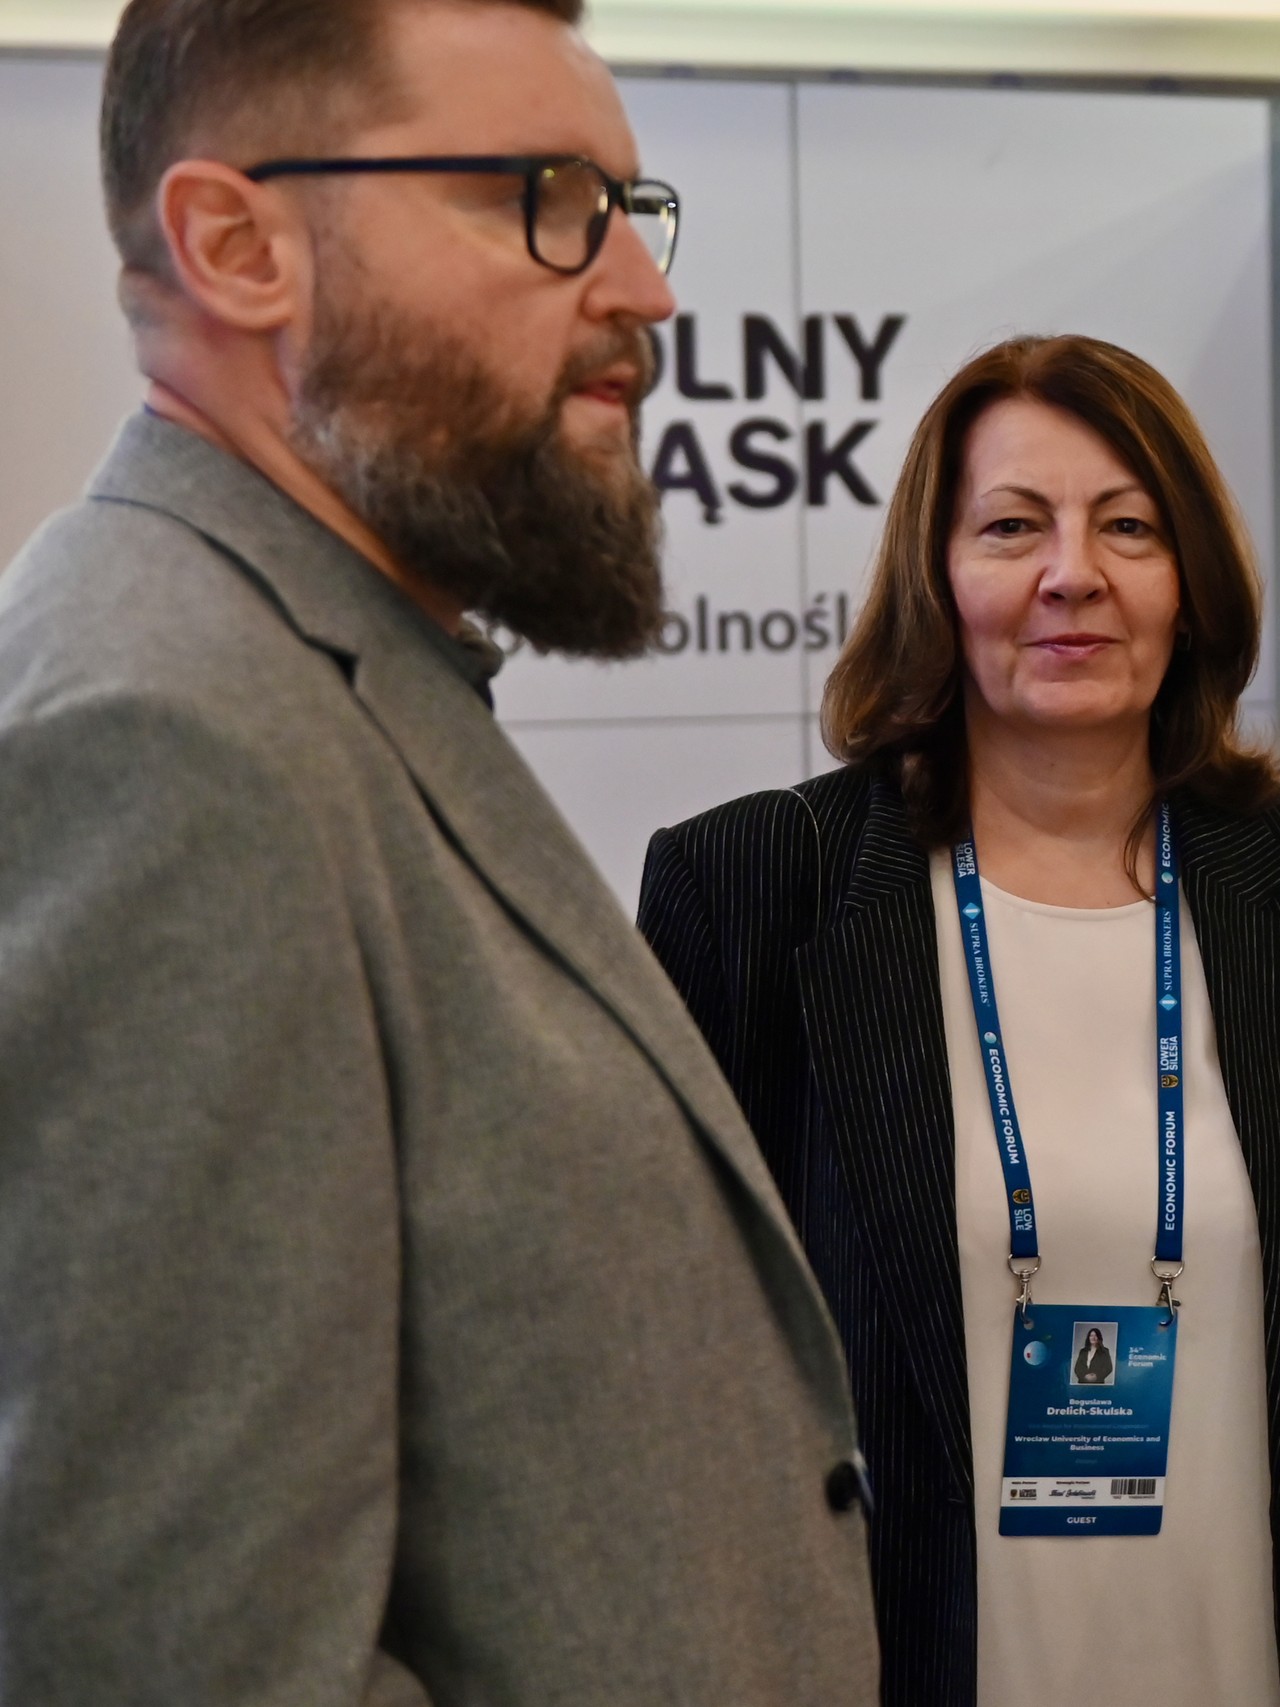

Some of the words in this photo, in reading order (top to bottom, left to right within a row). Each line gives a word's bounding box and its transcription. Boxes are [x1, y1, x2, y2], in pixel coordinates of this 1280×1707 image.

[1162, 802, 1171, 867] ECONOMIC
[963, 843, 976, 875] LOWER
[969, 922, 981, 955] SUPRA
[1163, 911, 1172, 957] BROKERS
[974, 956, 988, 1003] BROKERS
[1164, 959, 1173, 991] SUPRA
[1160, 1037, 1169, 1070] LOWER
[1168, 1035, 1178, 1070] SILESIA
[988, 1048, 1010, 1116] ECONOMIC
[1002, 1119, 1020, 1164] FORUM
[1166, 1111, 1176, 1155] FORUM
[1165, 1158, 1176, 1231] ECONOMIC
[1128, 1353, 1167, 1361] Economic
[1046, 1406, 1133, 1416] Drelich-Skulska
[1051, 1435, 1091, 1444] University
[1066, 1516, 1097, 1524] GUEST
